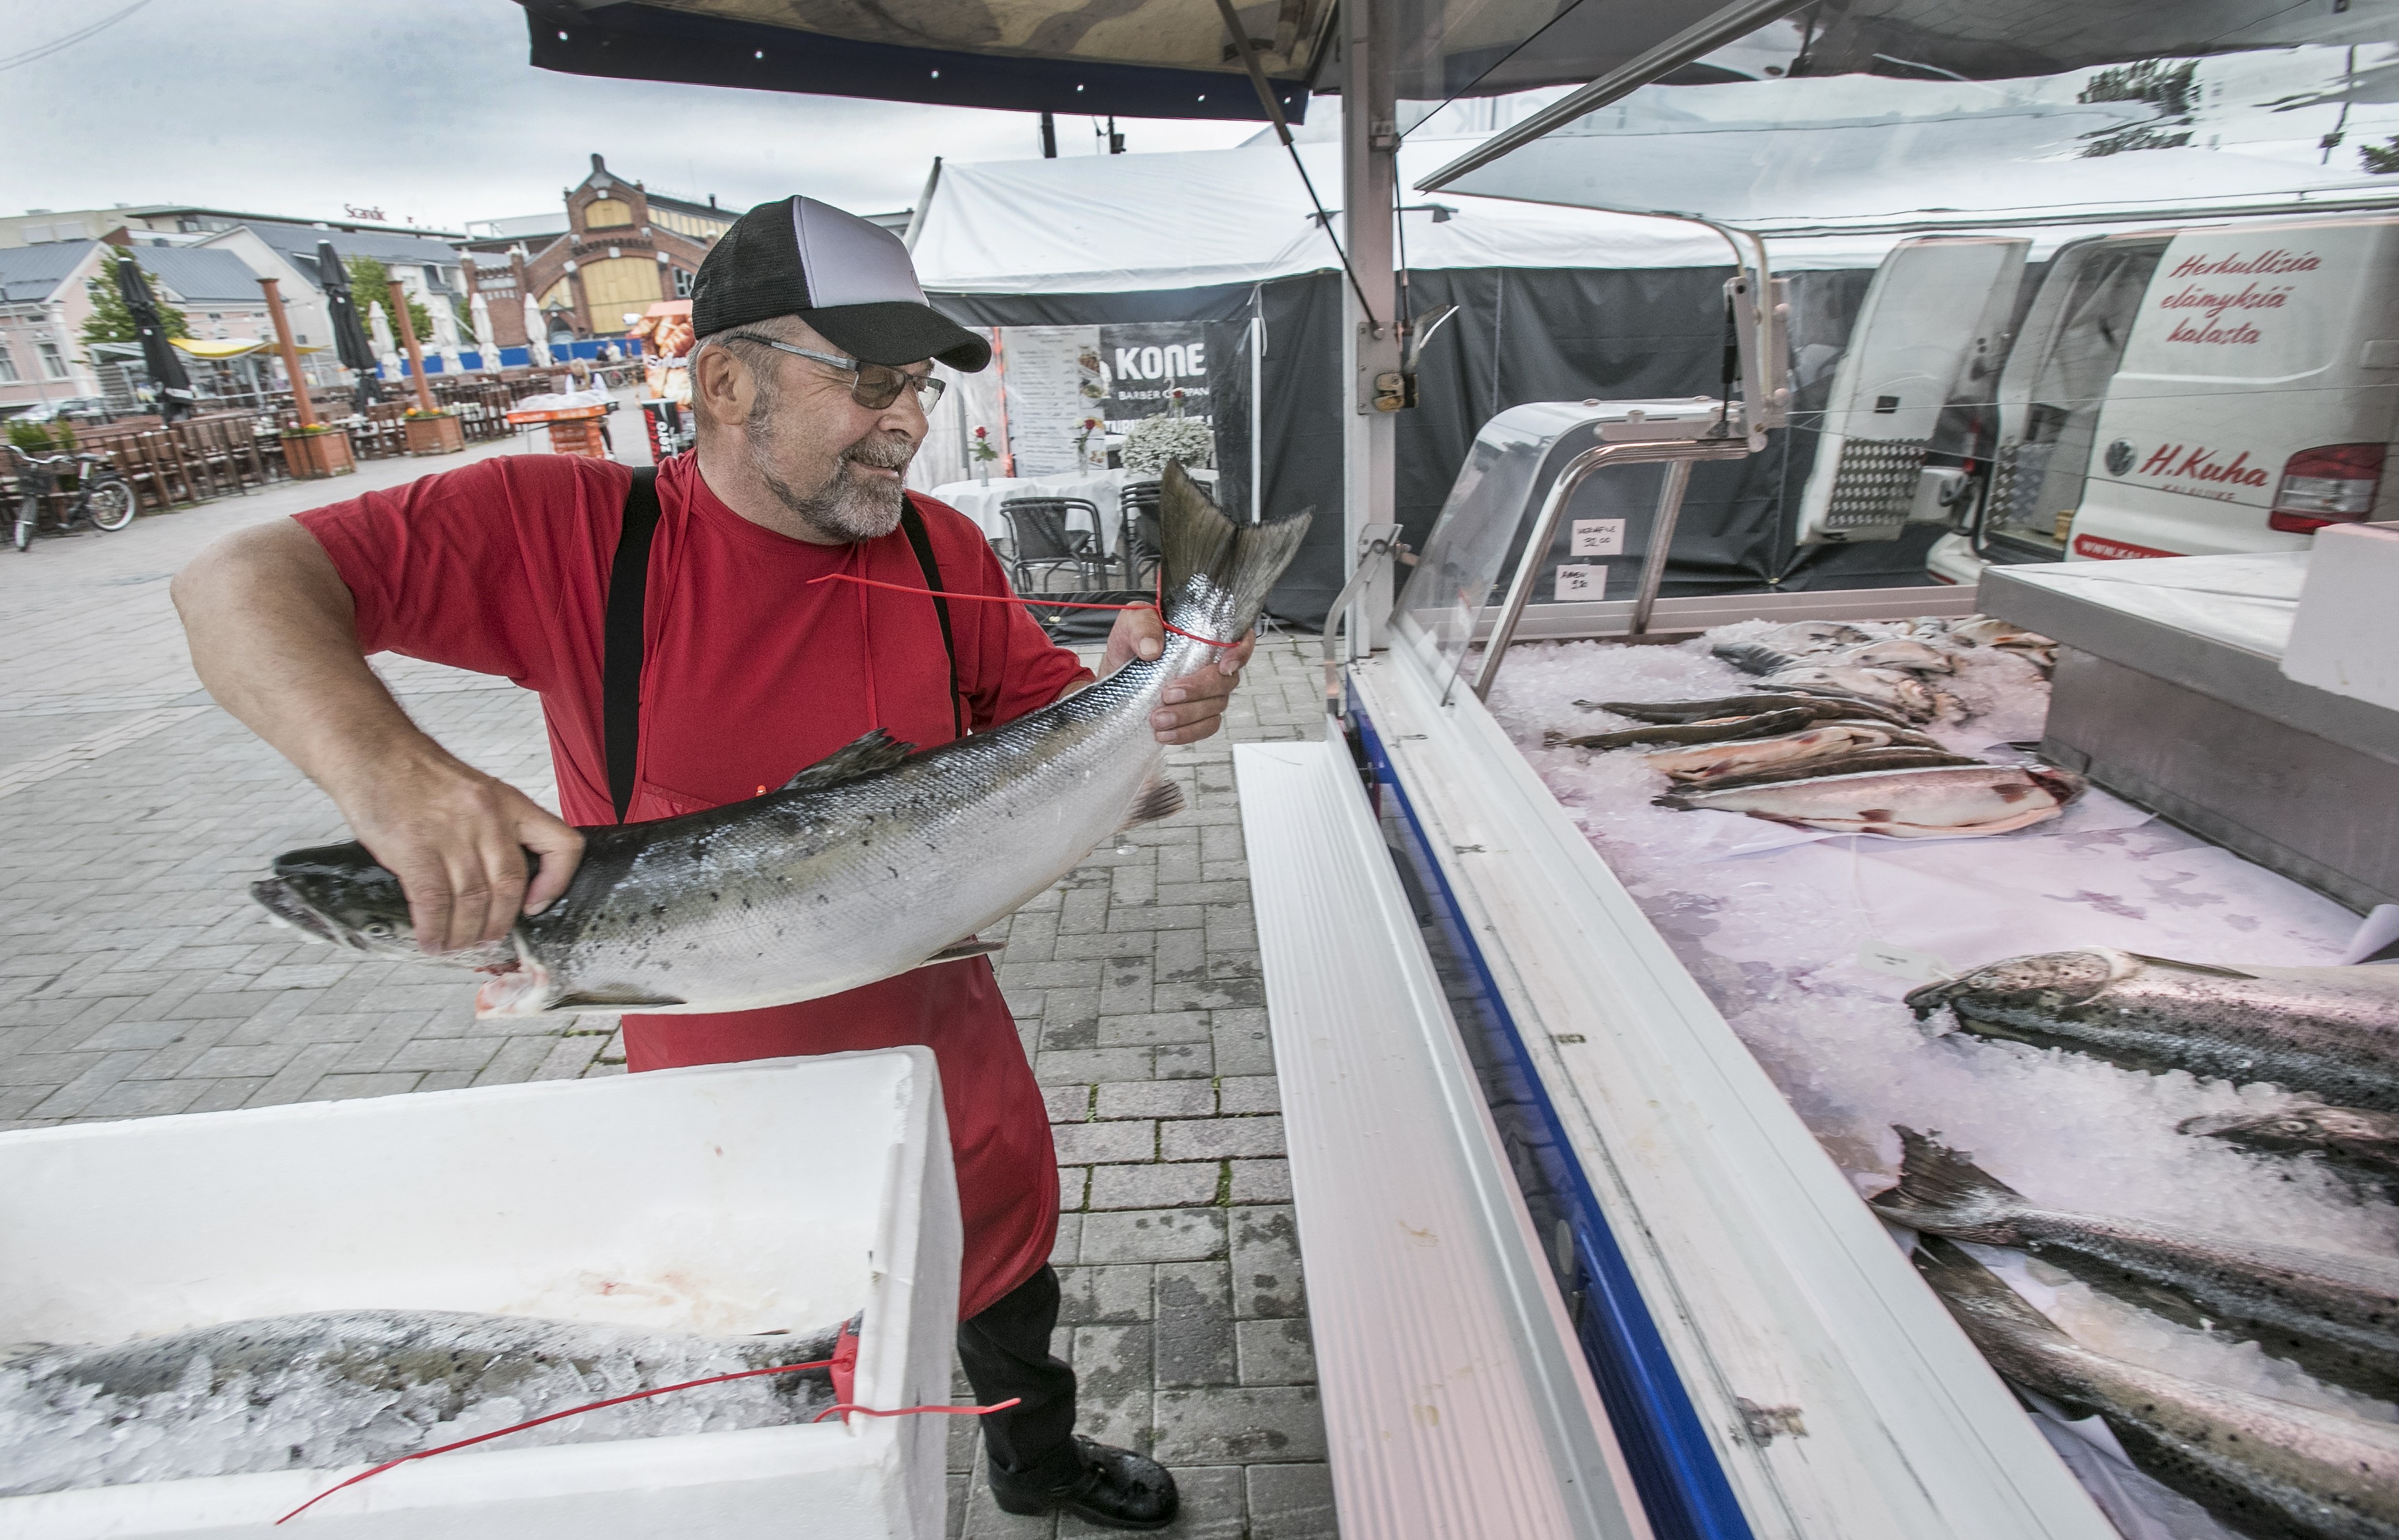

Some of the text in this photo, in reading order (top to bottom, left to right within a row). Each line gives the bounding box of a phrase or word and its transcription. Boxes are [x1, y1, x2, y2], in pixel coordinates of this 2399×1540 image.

[2168, 249, 2322, 278] Herkullisia
[2161, 281, 2295, 318] elämyksiä
[2166, 316, 2262, 345] kalasta
[2138, 443, 2270, 487] H.Kuha
